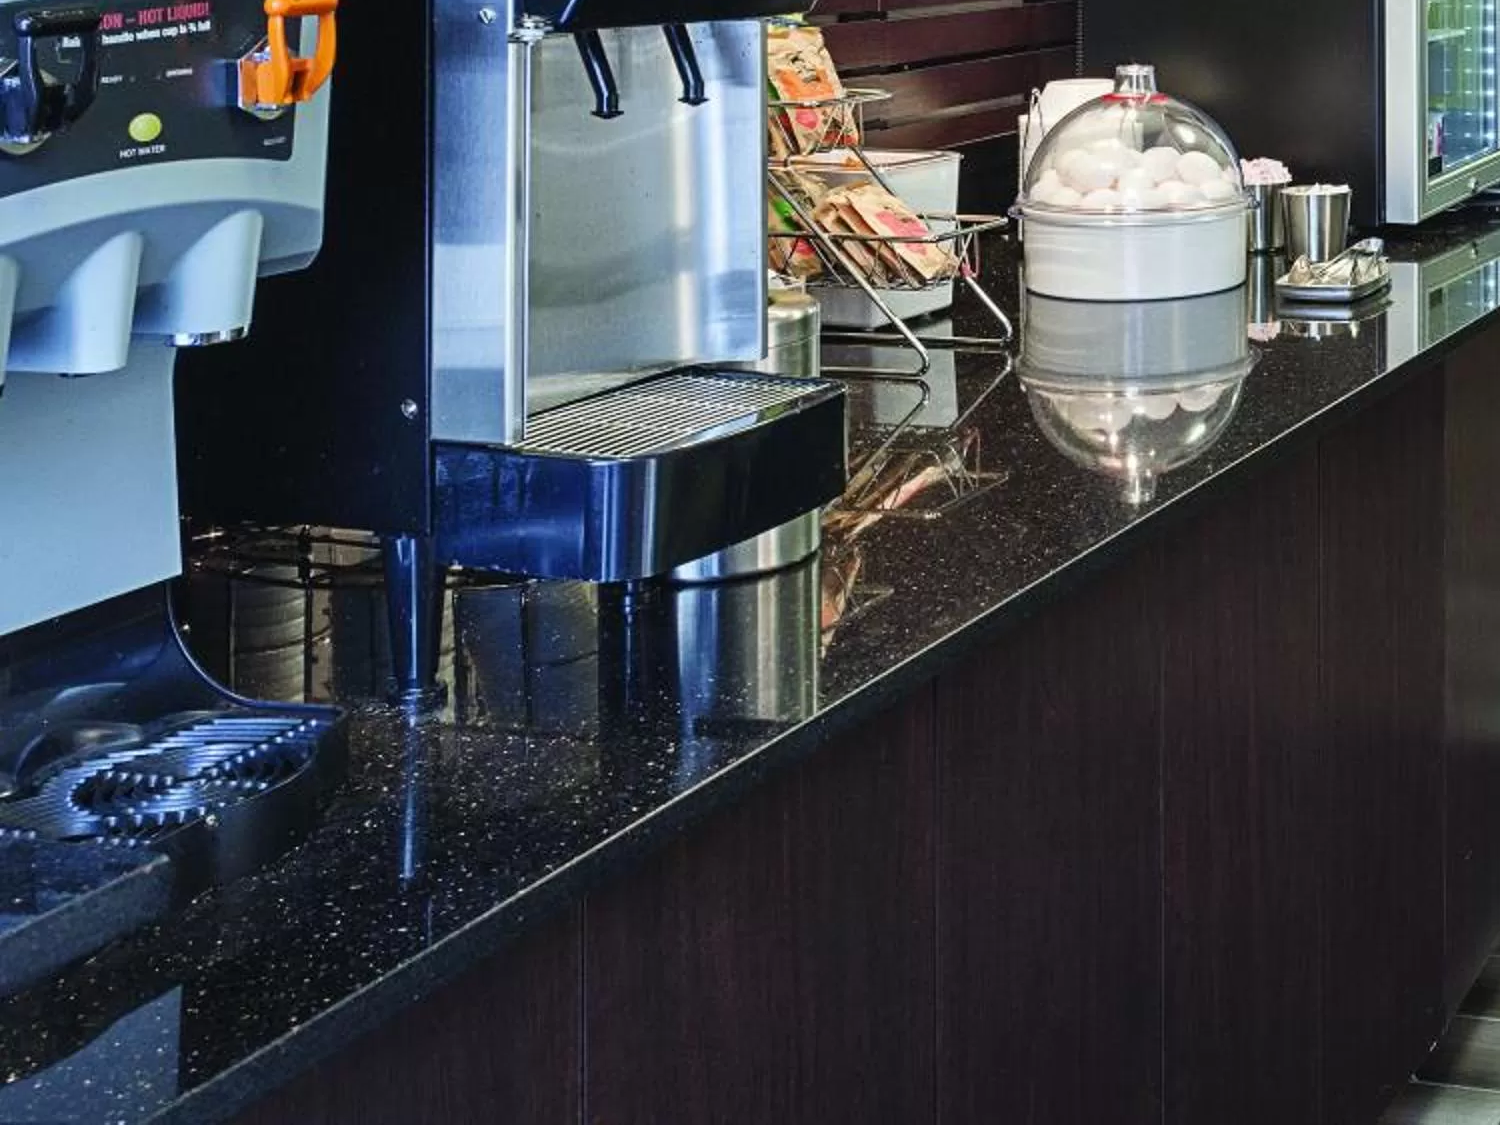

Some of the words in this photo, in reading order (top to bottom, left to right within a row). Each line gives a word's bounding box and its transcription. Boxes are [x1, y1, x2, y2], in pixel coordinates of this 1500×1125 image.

[139, 8, 164, 25] HOT
[167, 2, 210, 22] LIQUID!
[119, 148, 136, 159] HOT
[138, 144, 166, 156] WATER
